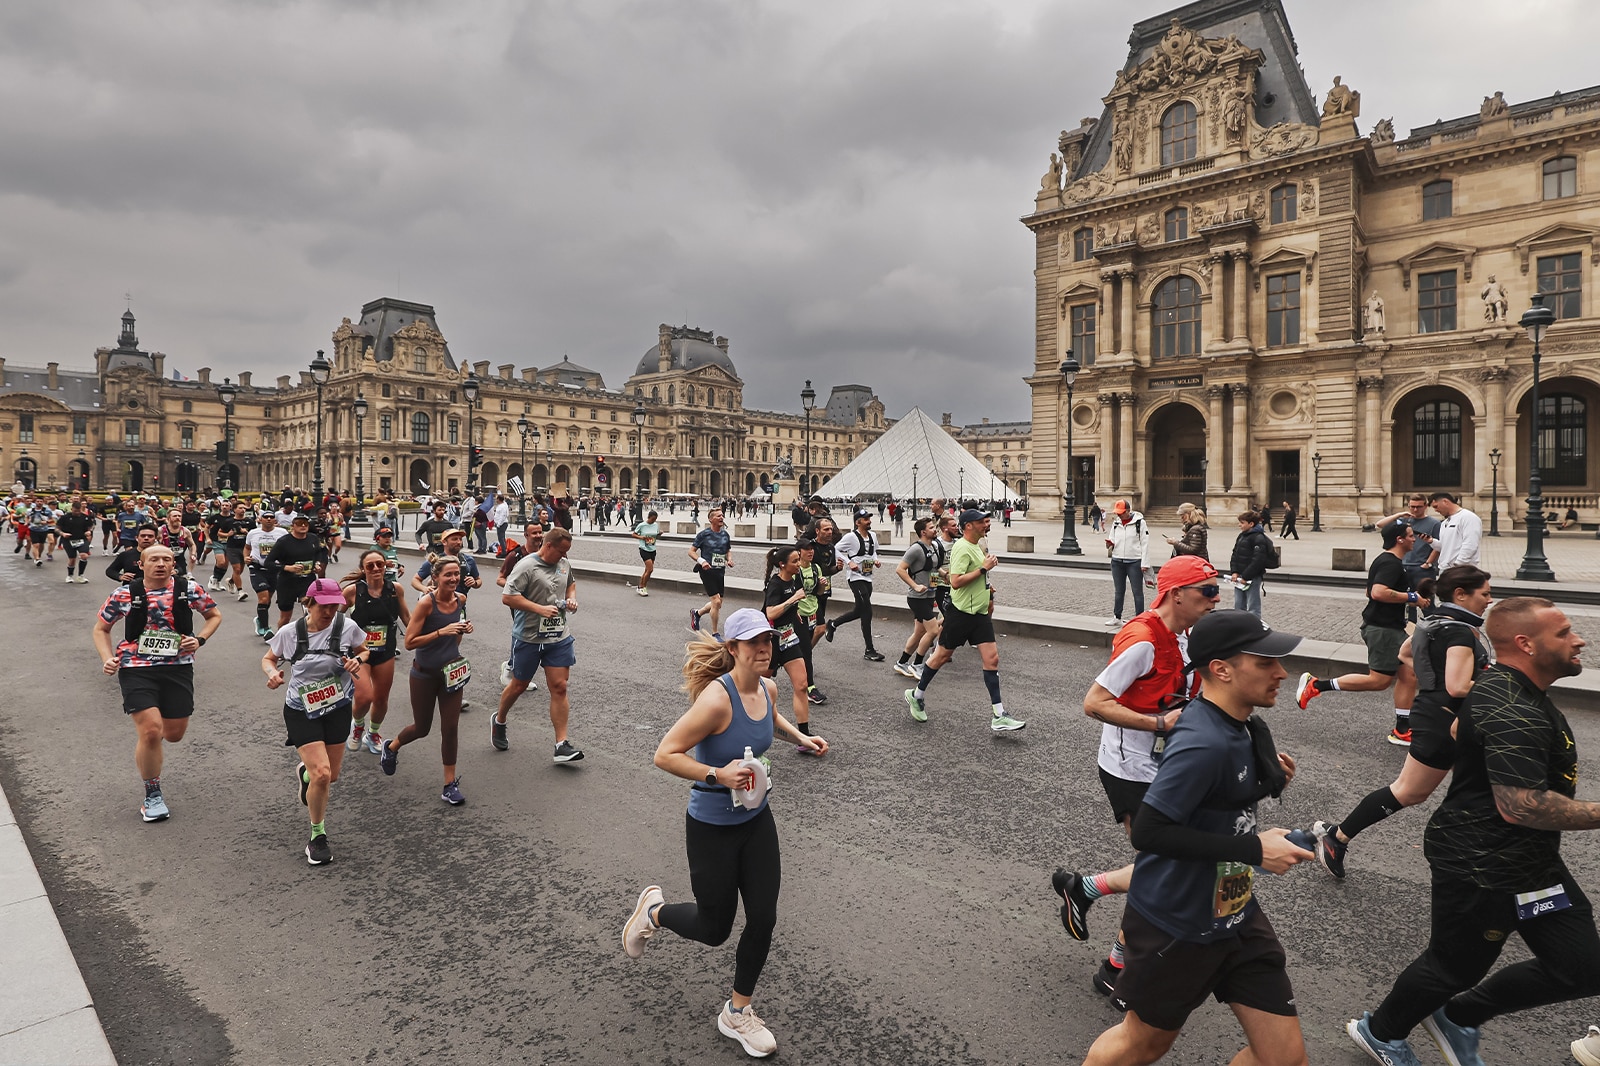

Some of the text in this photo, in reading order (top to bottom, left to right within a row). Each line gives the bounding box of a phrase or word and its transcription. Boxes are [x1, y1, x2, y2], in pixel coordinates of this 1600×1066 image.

[143, 637, 171, 650] 49753
[307, 685, 336, 704] 66030
[1539, 900, 1555, 912] asics
